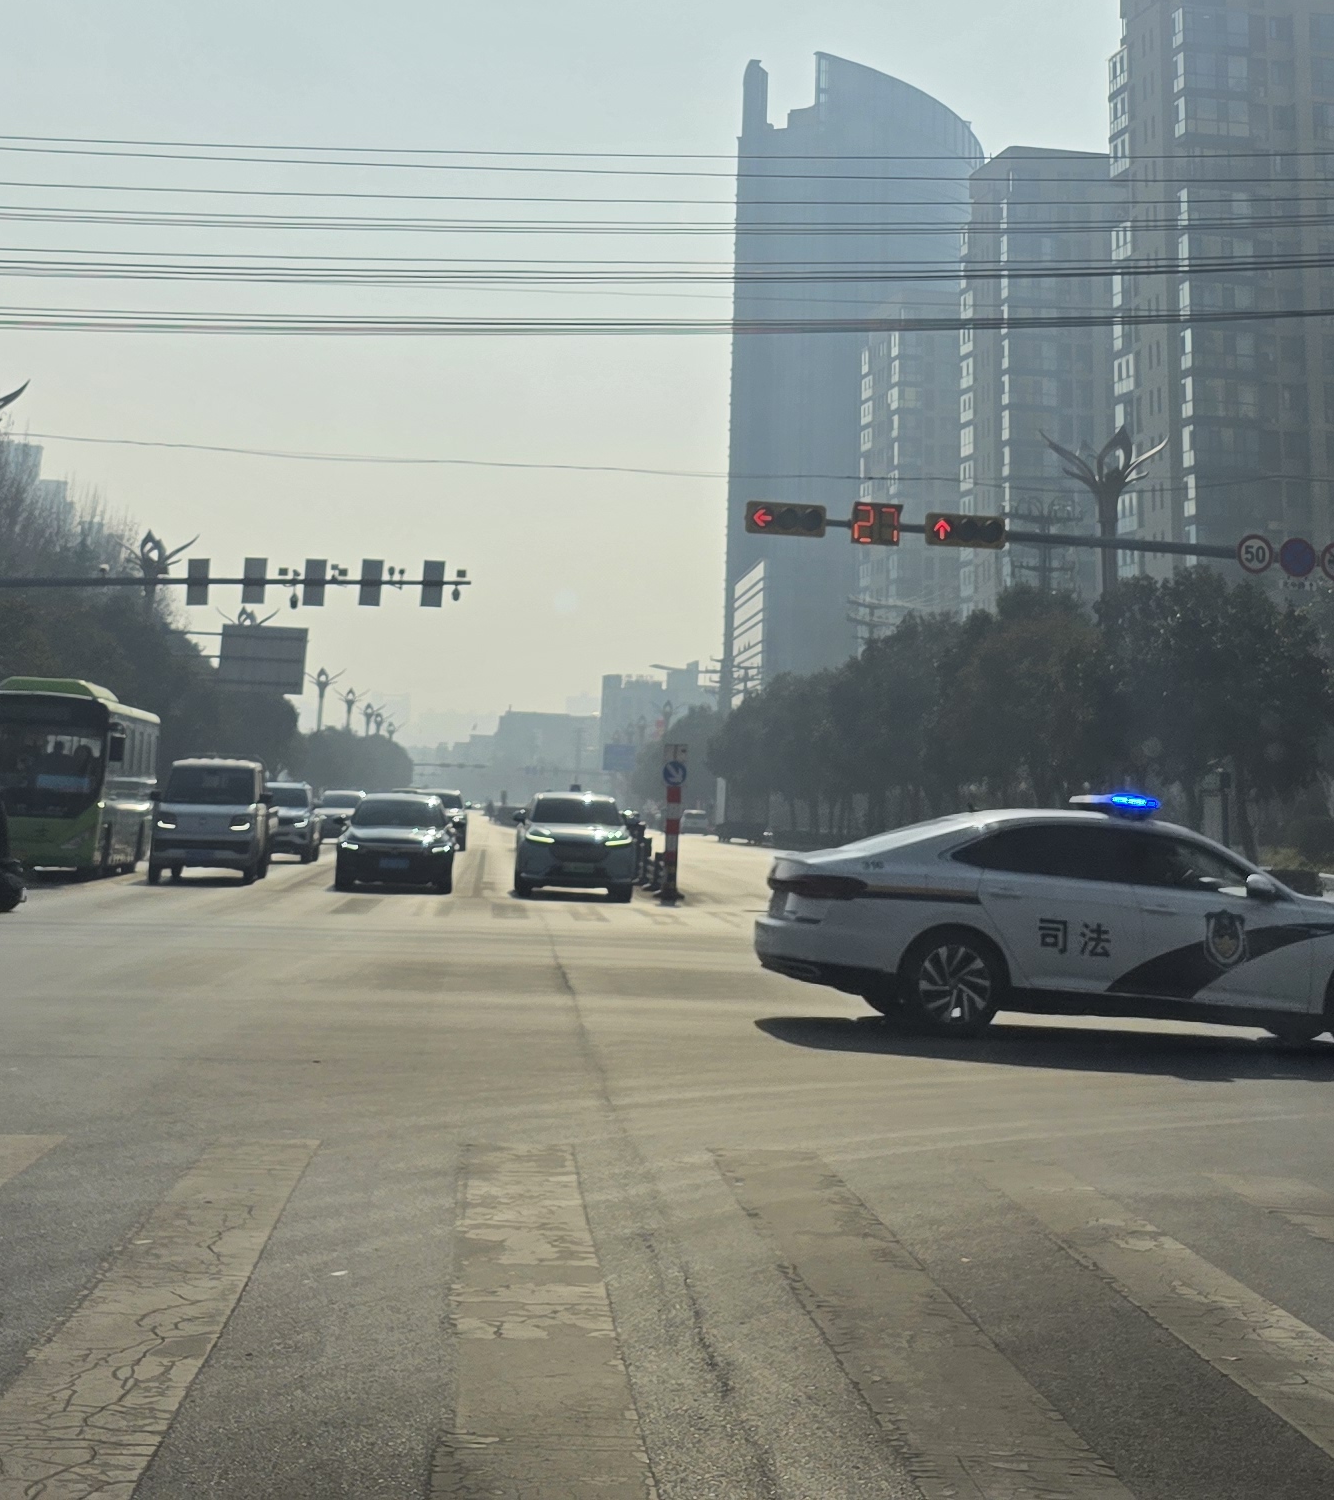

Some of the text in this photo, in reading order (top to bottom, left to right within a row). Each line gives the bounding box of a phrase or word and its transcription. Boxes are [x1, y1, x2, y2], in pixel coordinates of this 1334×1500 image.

[853, 504, 899, 544] 27
[1244, 545, 1266, 564] 50
[1038, 917, 1111, 958] 司法
